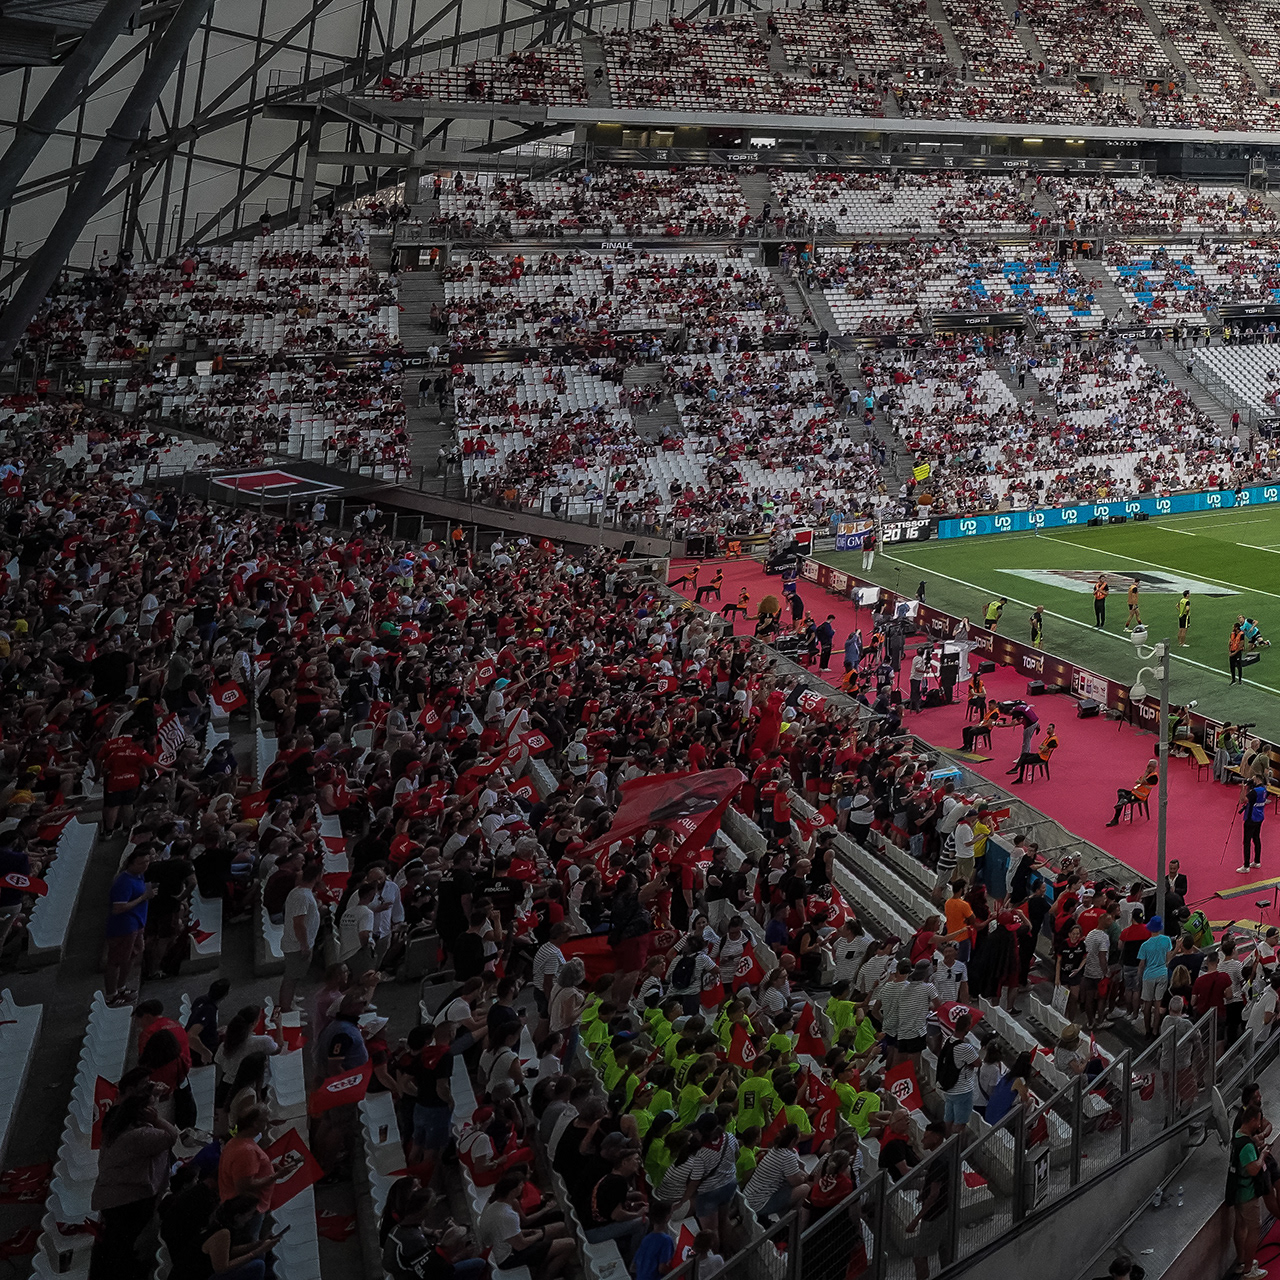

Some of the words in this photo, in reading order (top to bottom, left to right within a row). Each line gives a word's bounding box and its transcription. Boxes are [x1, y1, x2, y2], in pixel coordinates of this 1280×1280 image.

[727, 153, 759, 161] TOP14
[847, 534, 869, 547] GM
[883, 529, 901, 541] 20
[906, 526, 919, 539] 16
[1022, 654, 1045, 674] TOP14
[1138, 704, 1160, 723] TOP1
